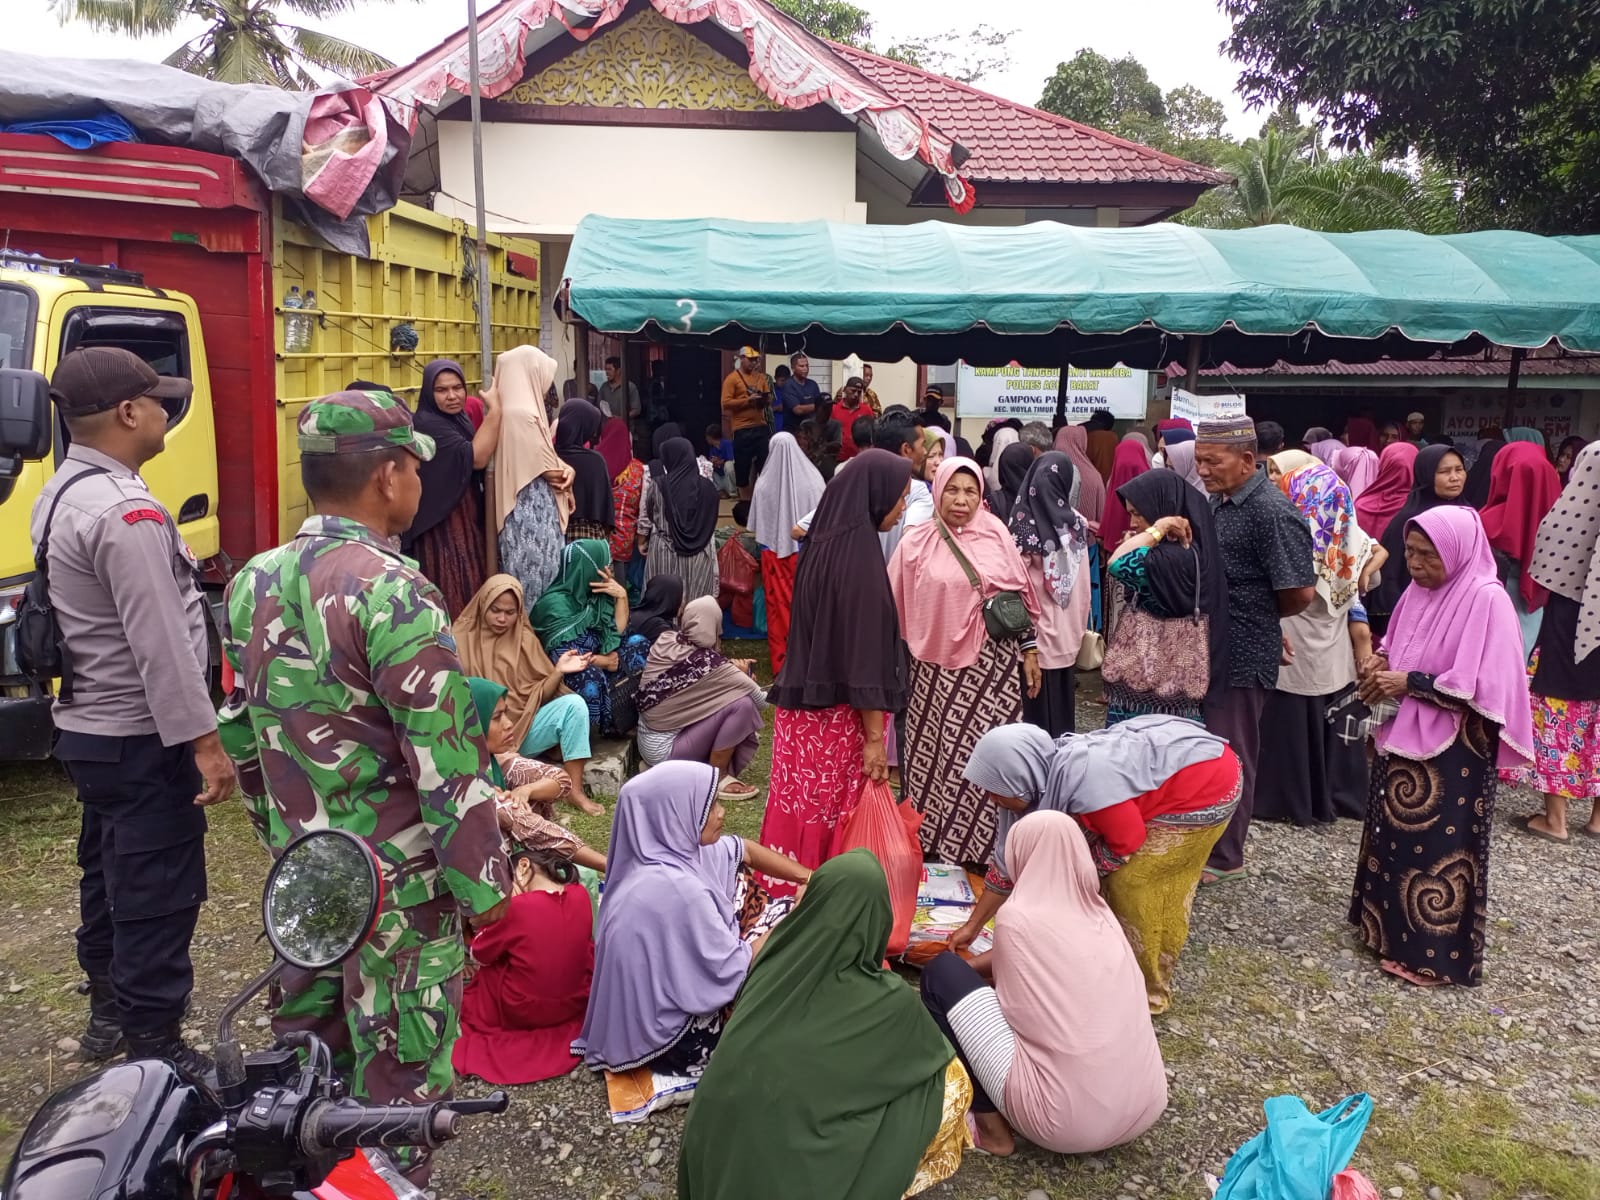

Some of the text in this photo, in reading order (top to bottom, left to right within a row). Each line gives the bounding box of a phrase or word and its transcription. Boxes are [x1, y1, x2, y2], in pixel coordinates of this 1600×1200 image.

[974, 366, 1020, 377] KAMPUNG
[1006, 380, 1042, 390] POLRES
[1070, 381, 1100, 391] BARAT
[998, 395, 1042, 404] GAMPONG
[1073, 395, 1107, 405] JANENG
[1447, 415, 1475, 429] AYO
